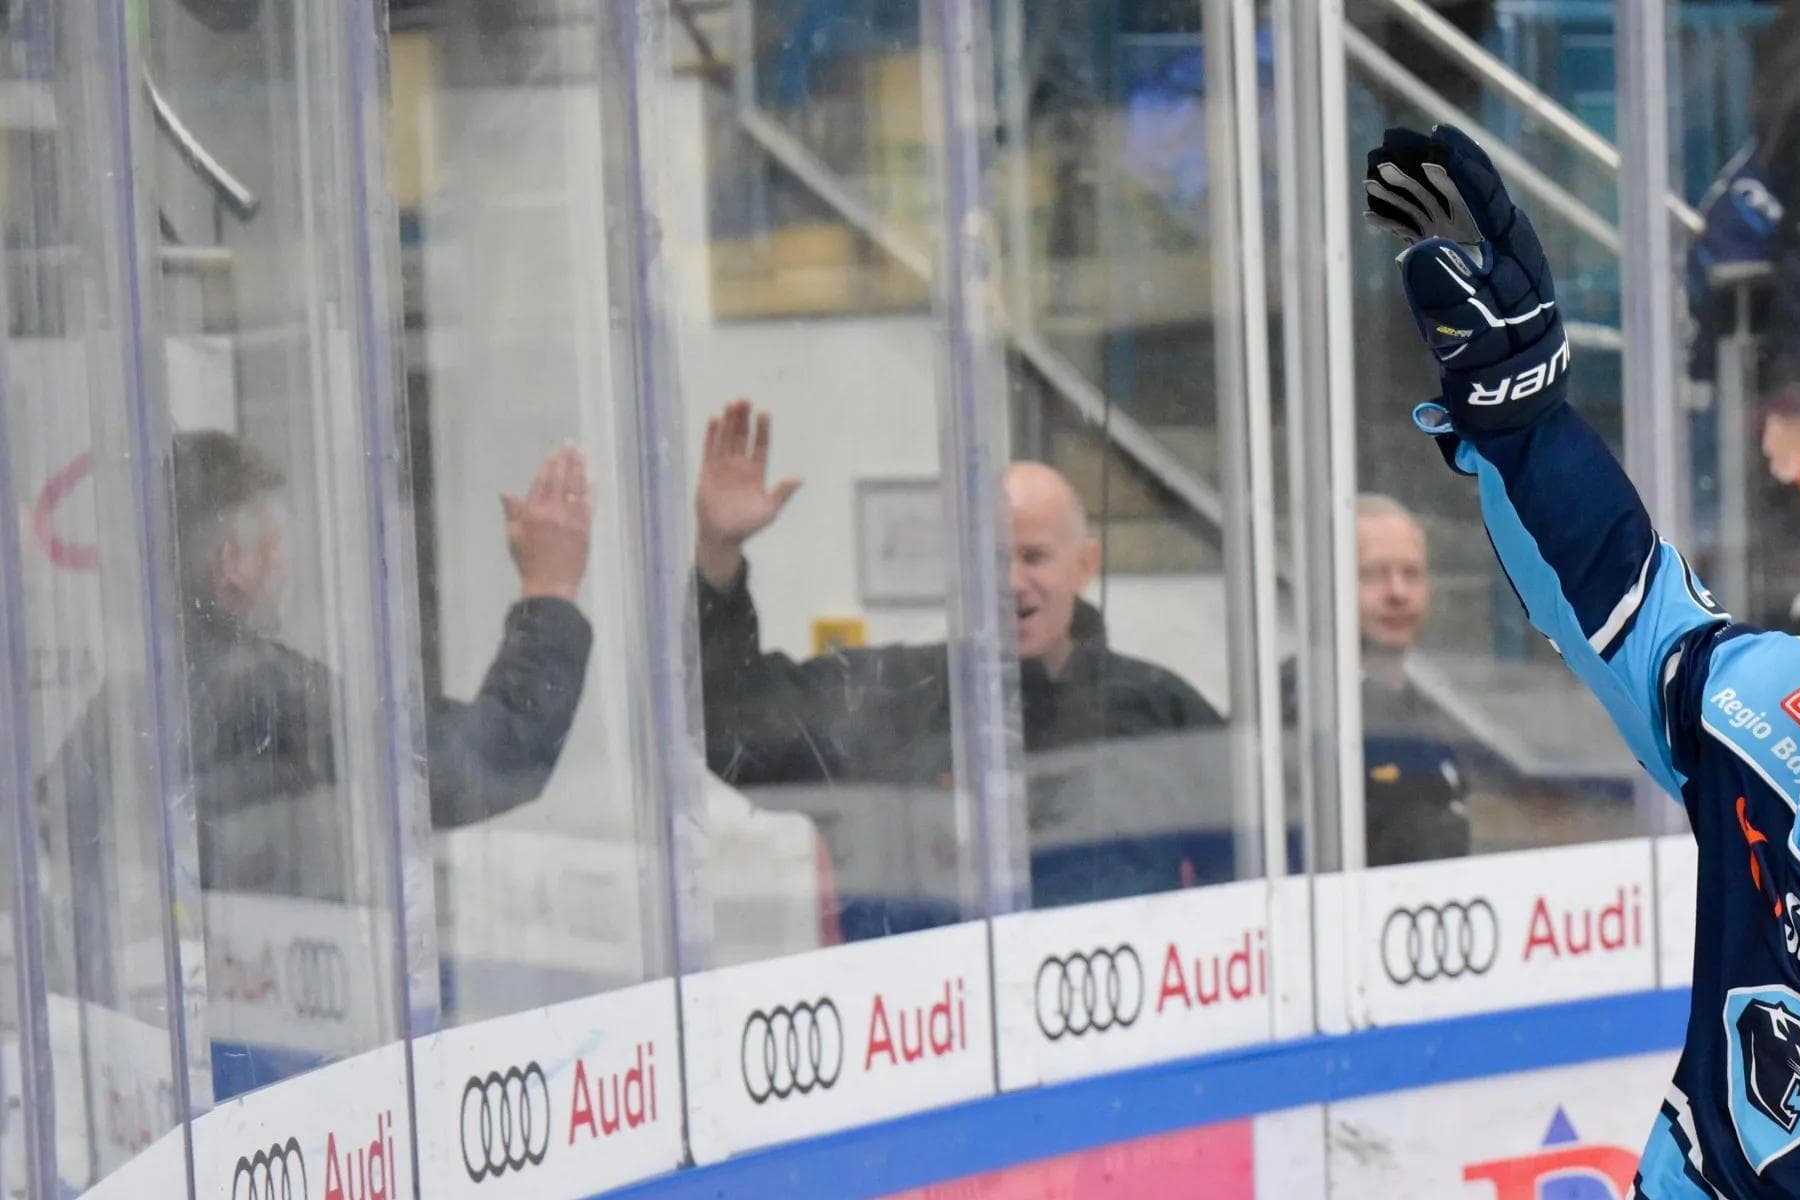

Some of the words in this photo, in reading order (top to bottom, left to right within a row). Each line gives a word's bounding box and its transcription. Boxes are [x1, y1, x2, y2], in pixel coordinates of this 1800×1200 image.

[1468, 330, 1571, 407] UER
[1710, 687, 1772, 740] Regio
[1522, 885, 1642, 964] Audi
[1156, 930, 1268, 1014] Audi
[865, 977, 967, 1072] Audi
[569, 1041, 657, 1147] Audi
